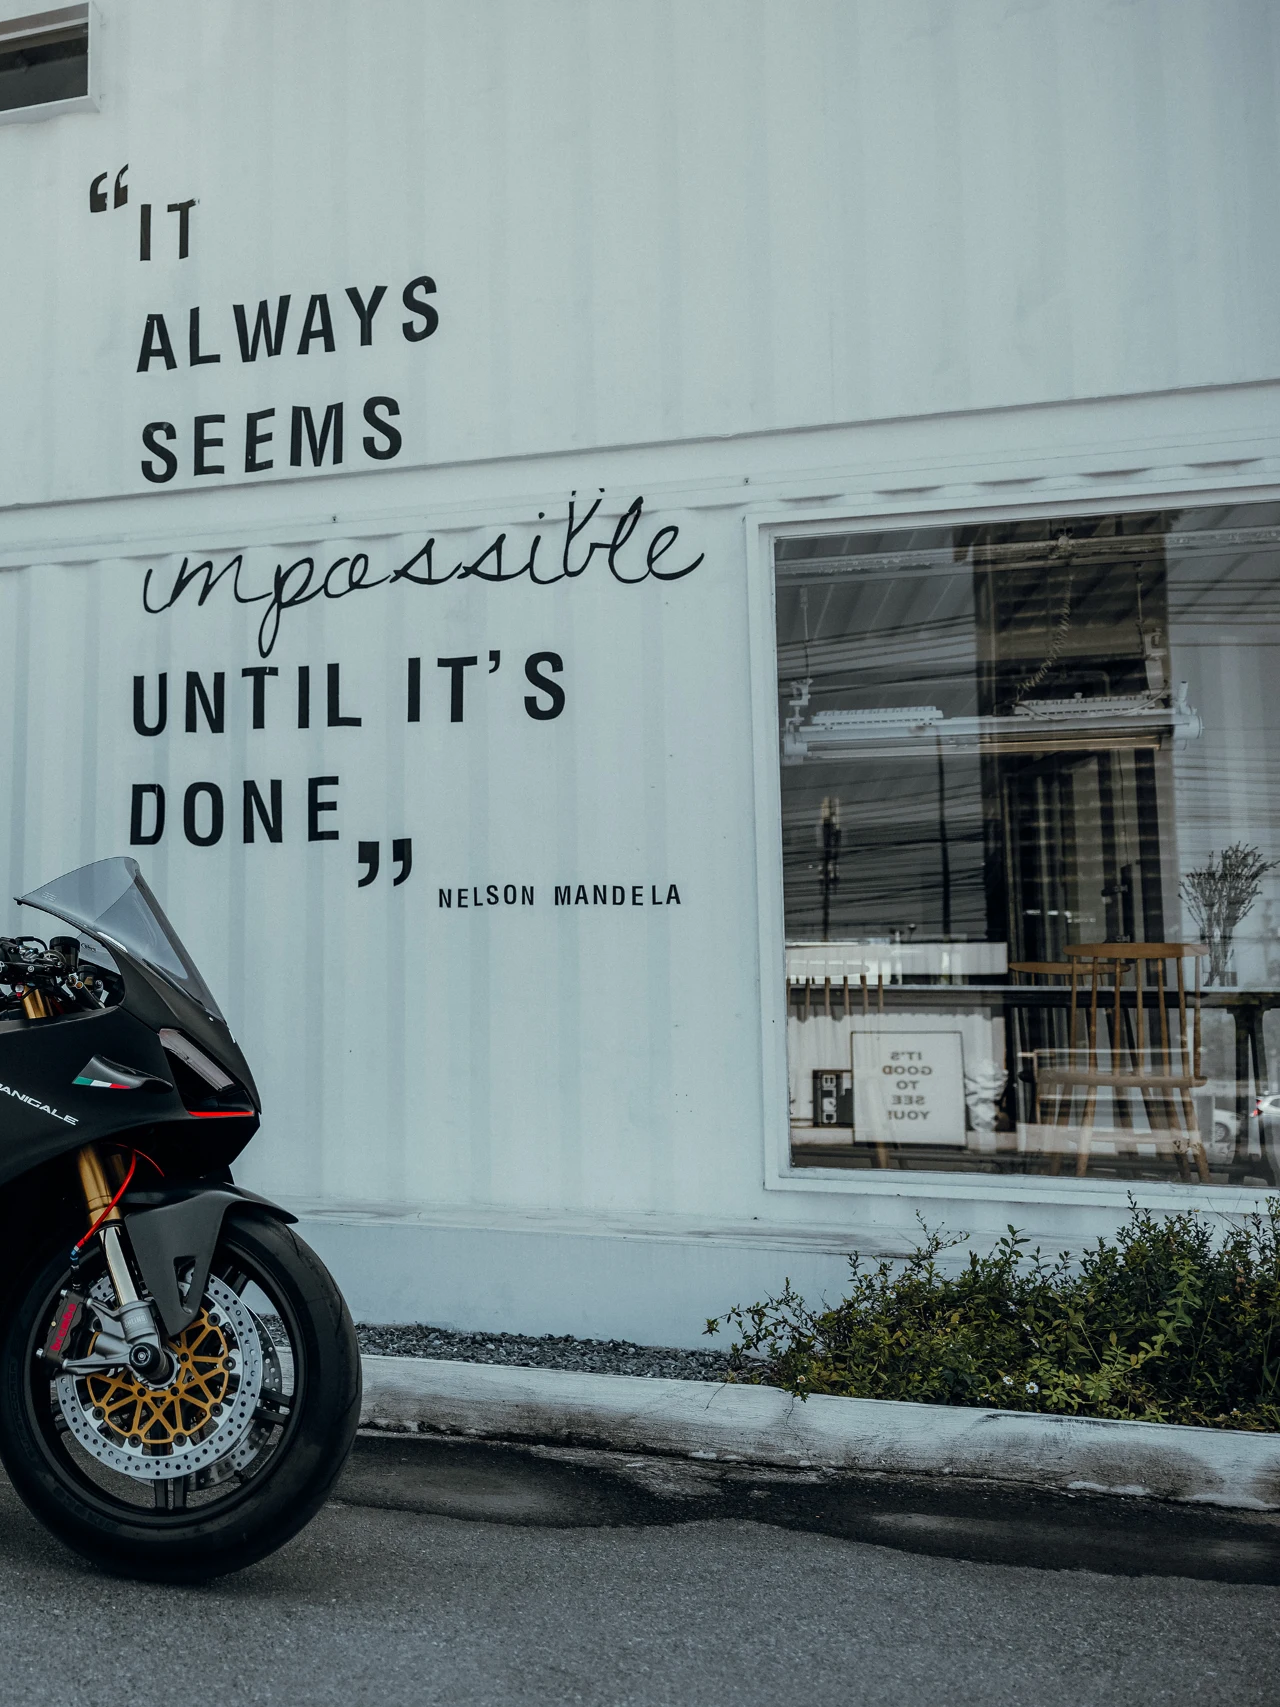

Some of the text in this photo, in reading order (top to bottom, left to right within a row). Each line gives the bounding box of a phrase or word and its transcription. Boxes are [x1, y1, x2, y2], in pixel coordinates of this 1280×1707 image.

[136, 275, 439, 373] ALWAYS
[141, 396, 402, 484] SEEMS
[143, 488, 705, 658] impossible
[133, 649, 566, 737] UNTIL IT’S
[438, 883, 682, 909] NELSON MANDELA
[49, 1303, 77, 1351] brembo
